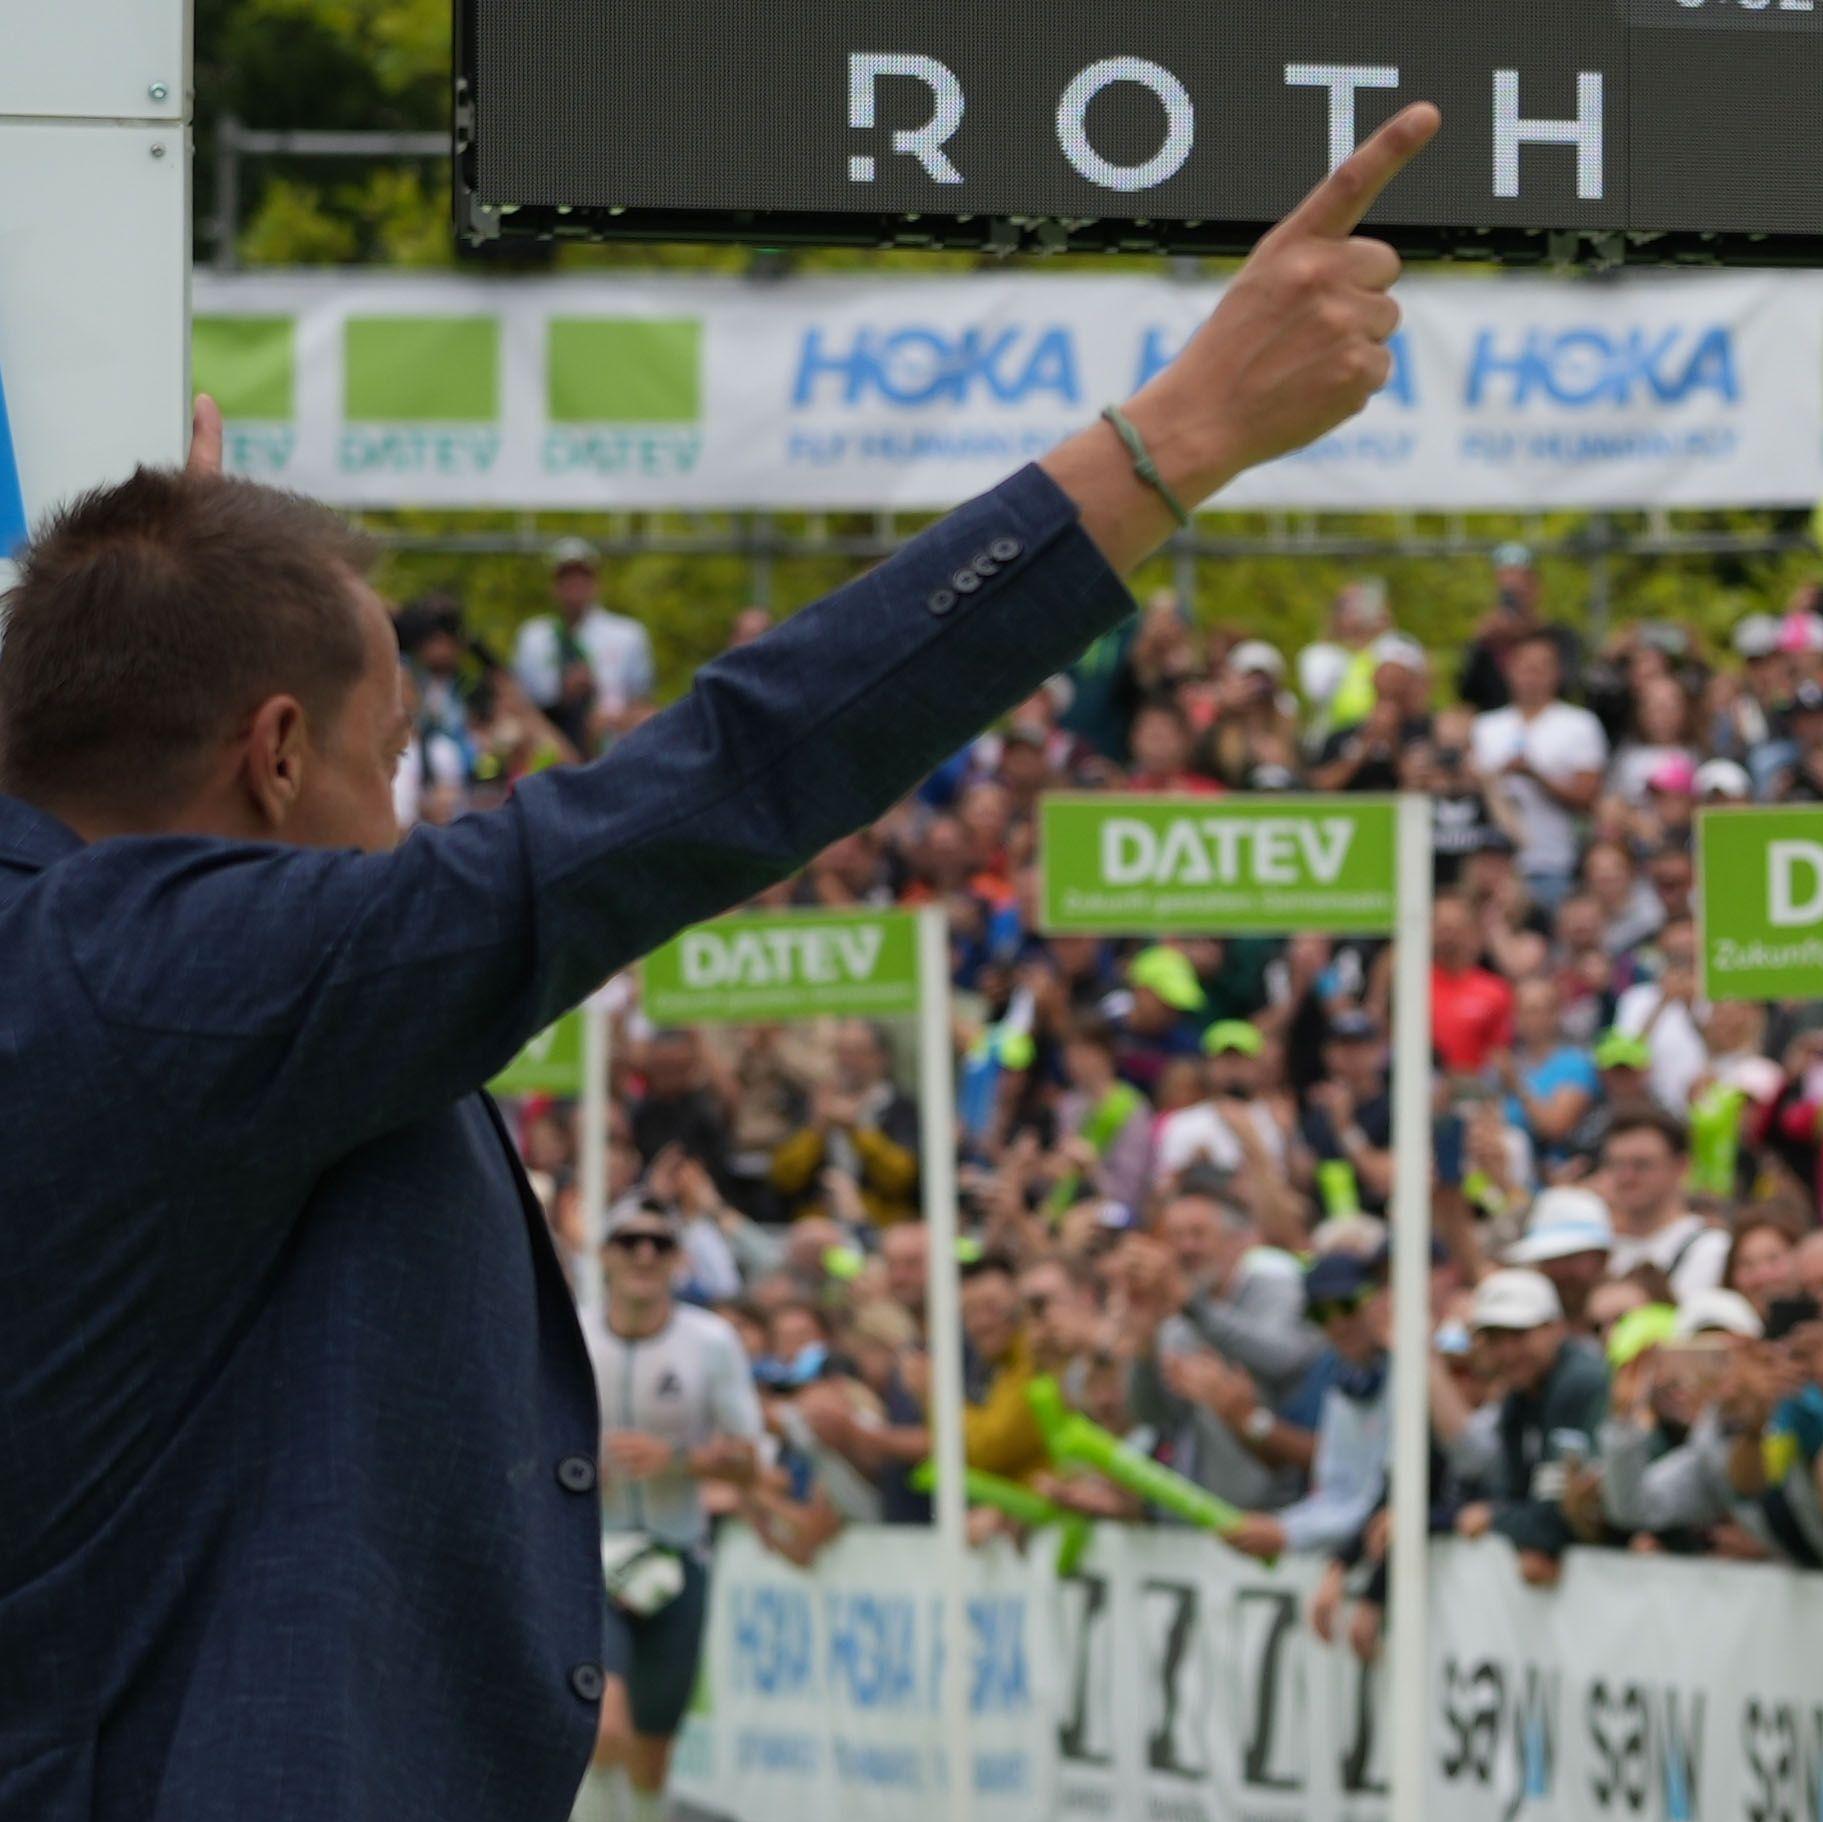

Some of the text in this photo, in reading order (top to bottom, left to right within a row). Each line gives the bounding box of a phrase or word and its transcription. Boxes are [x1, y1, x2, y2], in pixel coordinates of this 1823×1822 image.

[849, 52, 1603, 199] ROTH
[793, 326, 1079, 408] HOKA
[1466, 326, 1741, 408] HOKA
[1103, 819, 1356, 885] DATEV
[682, 926, 885, 986] DATEV
